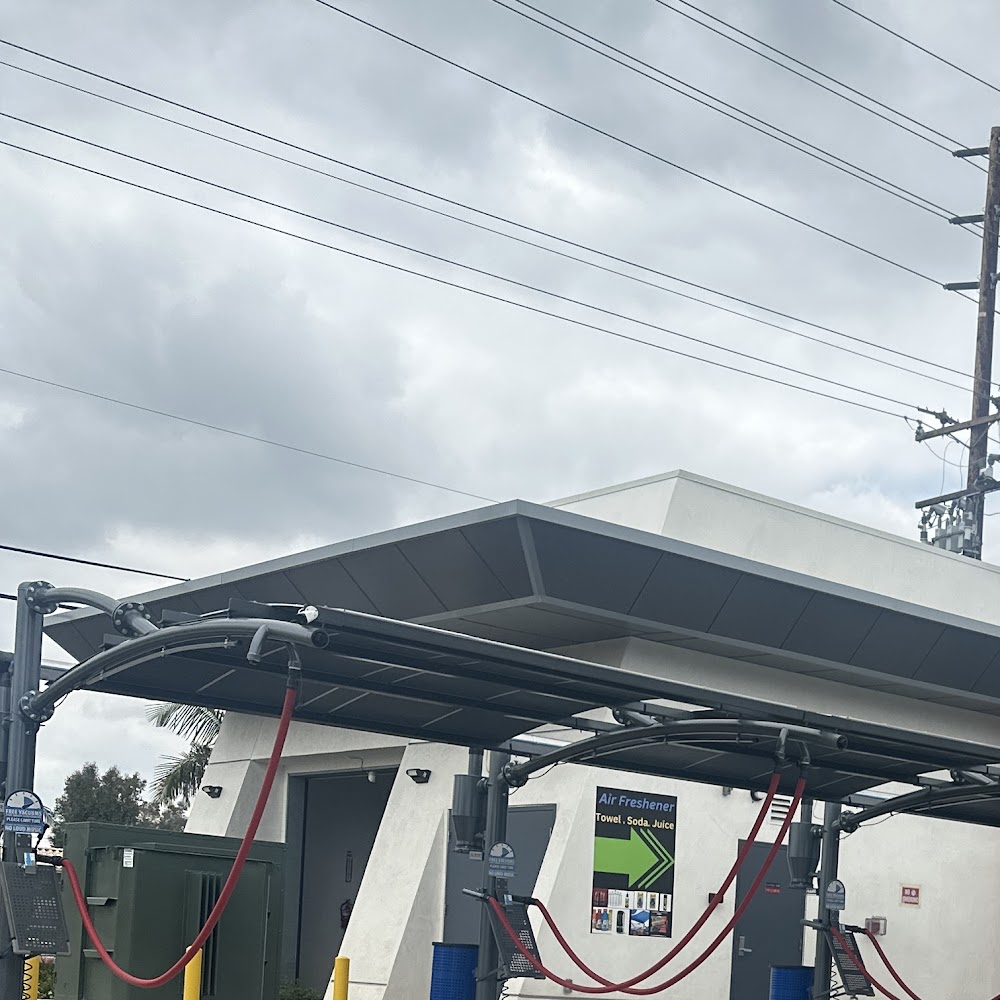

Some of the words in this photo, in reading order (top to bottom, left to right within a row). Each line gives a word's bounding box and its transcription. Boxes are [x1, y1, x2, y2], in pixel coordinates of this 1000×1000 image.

[599, 793, 617, 805] Air
[618, 795, 675, 812] Freshener
[595, 812, 621, 824] Towel
[651, 819, 675, 830] Juice
